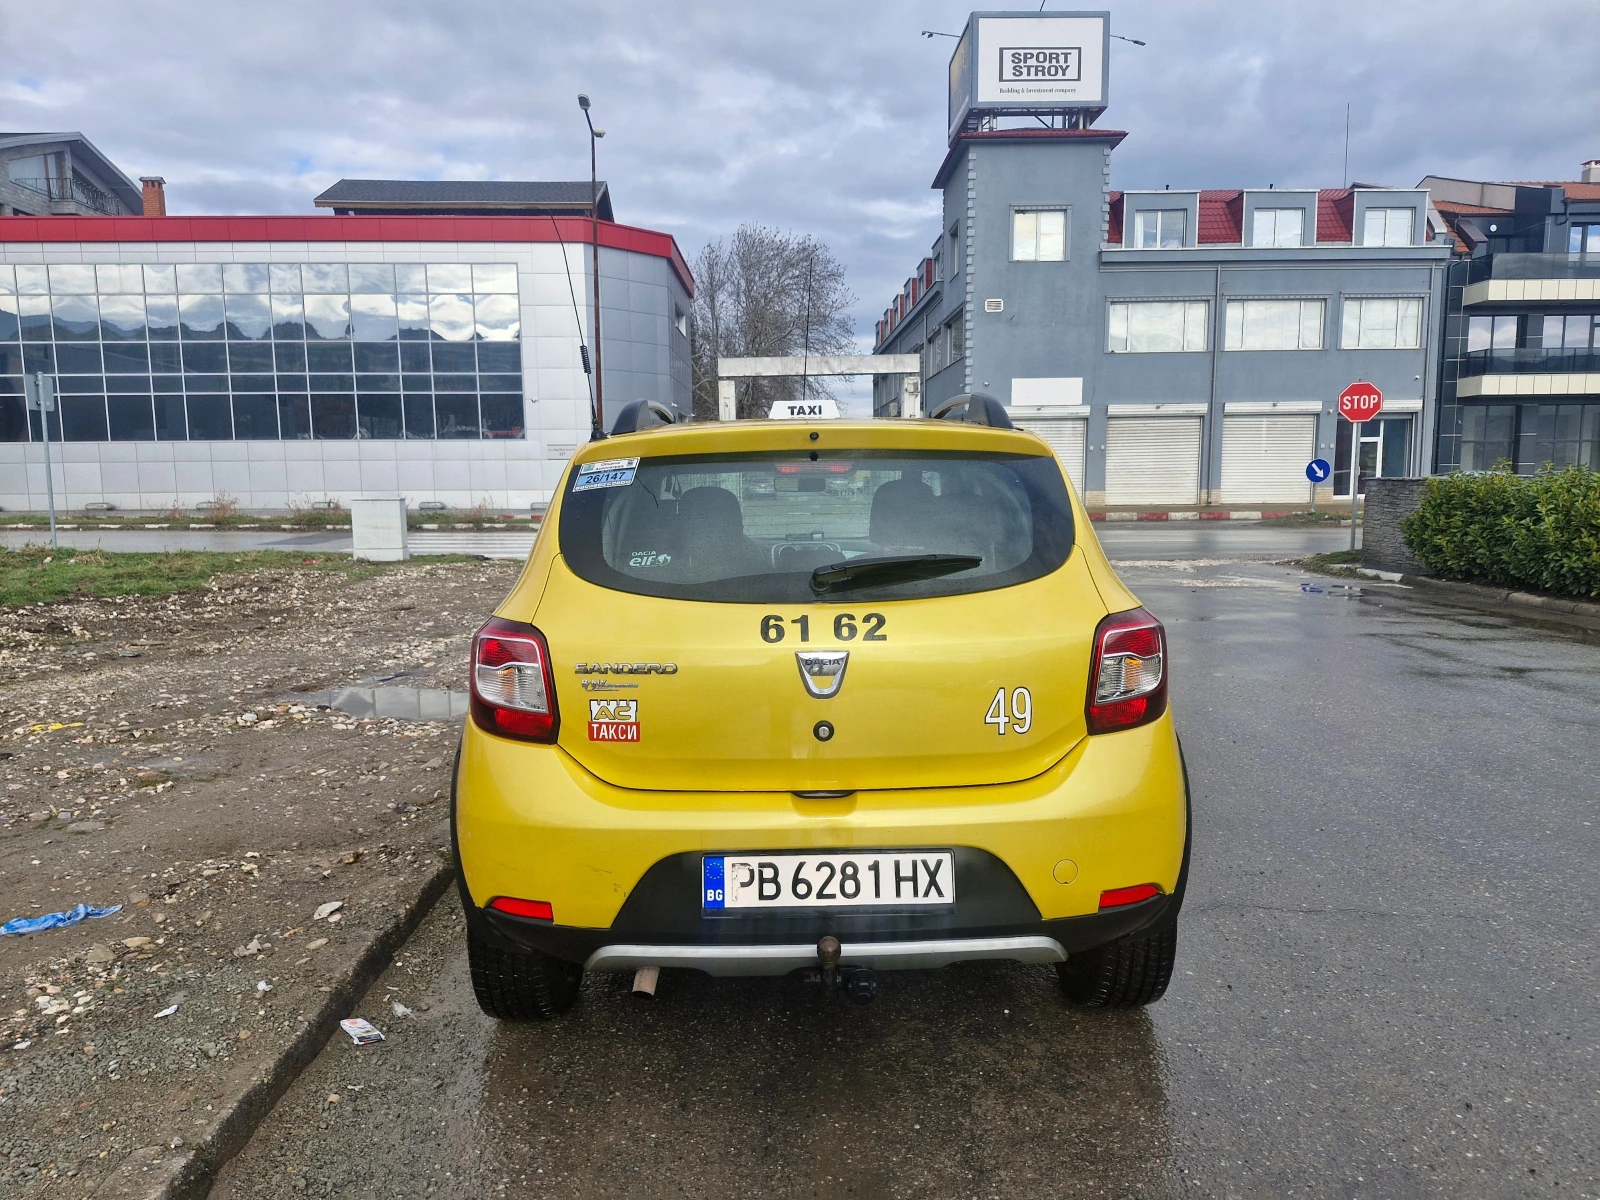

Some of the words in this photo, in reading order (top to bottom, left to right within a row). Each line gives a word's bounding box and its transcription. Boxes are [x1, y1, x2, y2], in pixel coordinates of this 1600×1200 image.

[1011, 51, 1072, 64] SPORT
[1012, 65, 1070, 77] STROY
[999, 87, 1020, 95] Building
[1342, 394, 1379, 410] STOP
[787, 404, 822, 416] TAXI
[585, 471, 626, 484] 26/147
[629, 556, 657, 567] elf
[760, 613, 810, 643] 61
[833, 612, 888, 642] 62
[574, 662, 678, 675] SANDERO
[804, 658, 841, 666] DACIA
[984, 686, 1033, 736] 49
[591, 723, 637, 740] ТАКСИ
[731, 861, 782, 902] PB
[791, 859, 881, 901] 6281
[894, 858, 945, 899] HX
[706, 889, 723, 902] BG
